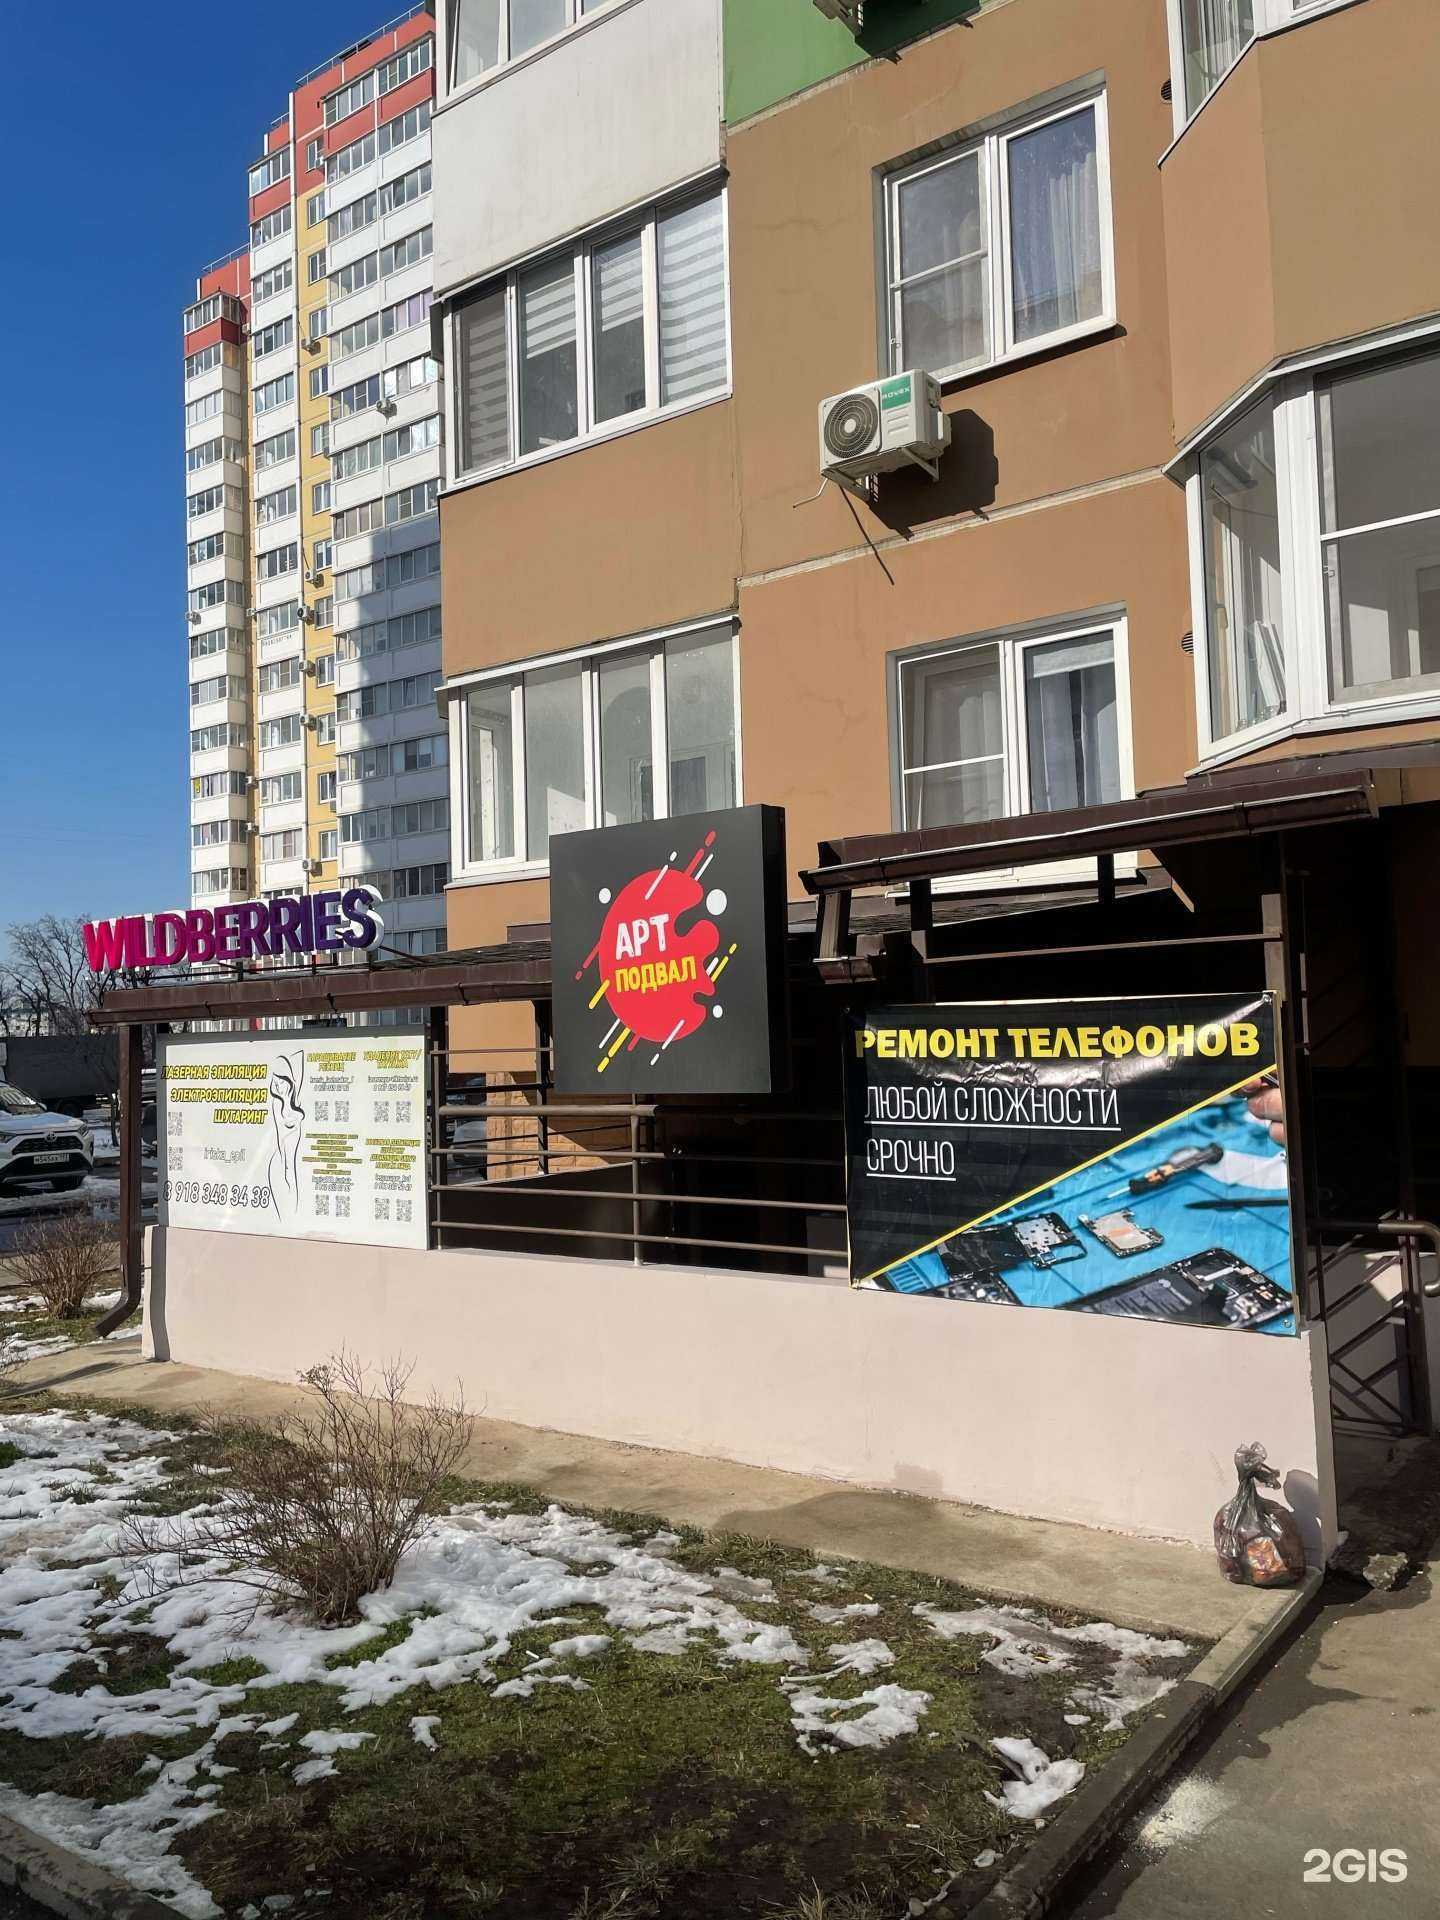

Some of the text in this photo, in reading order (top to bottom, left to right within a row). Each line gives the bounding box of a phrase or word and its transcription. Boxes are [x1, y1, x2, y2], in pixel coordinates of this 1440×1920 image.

[82, 885, 384, 973] WILDBERRIES
[615, 913, 670, 961] АРТ
[615, 955, 697, 994] ПОДВАЛ
[855, 1022, 1260, 1059] РЕМОНТ ТЕЛЕФОНОВ
[161, 1064, 268, 1081] ЛАЗЕРНАЯ ЭПИЛЯЦИЯ
[170, 1088, 268, 1105] ЭЛЕКТРОЭПИЛЯЦИЯ
[864, 1081, 1120, 1125] ЛЮБОЙ СЛОЖНОСТИ
[213, 1109, 268, 1124] ШУГАРИНГ
[866, 1138, 956, 1176] СРОЧНО
[163, 1180, 270, 1208] 8 918 348 34 38
